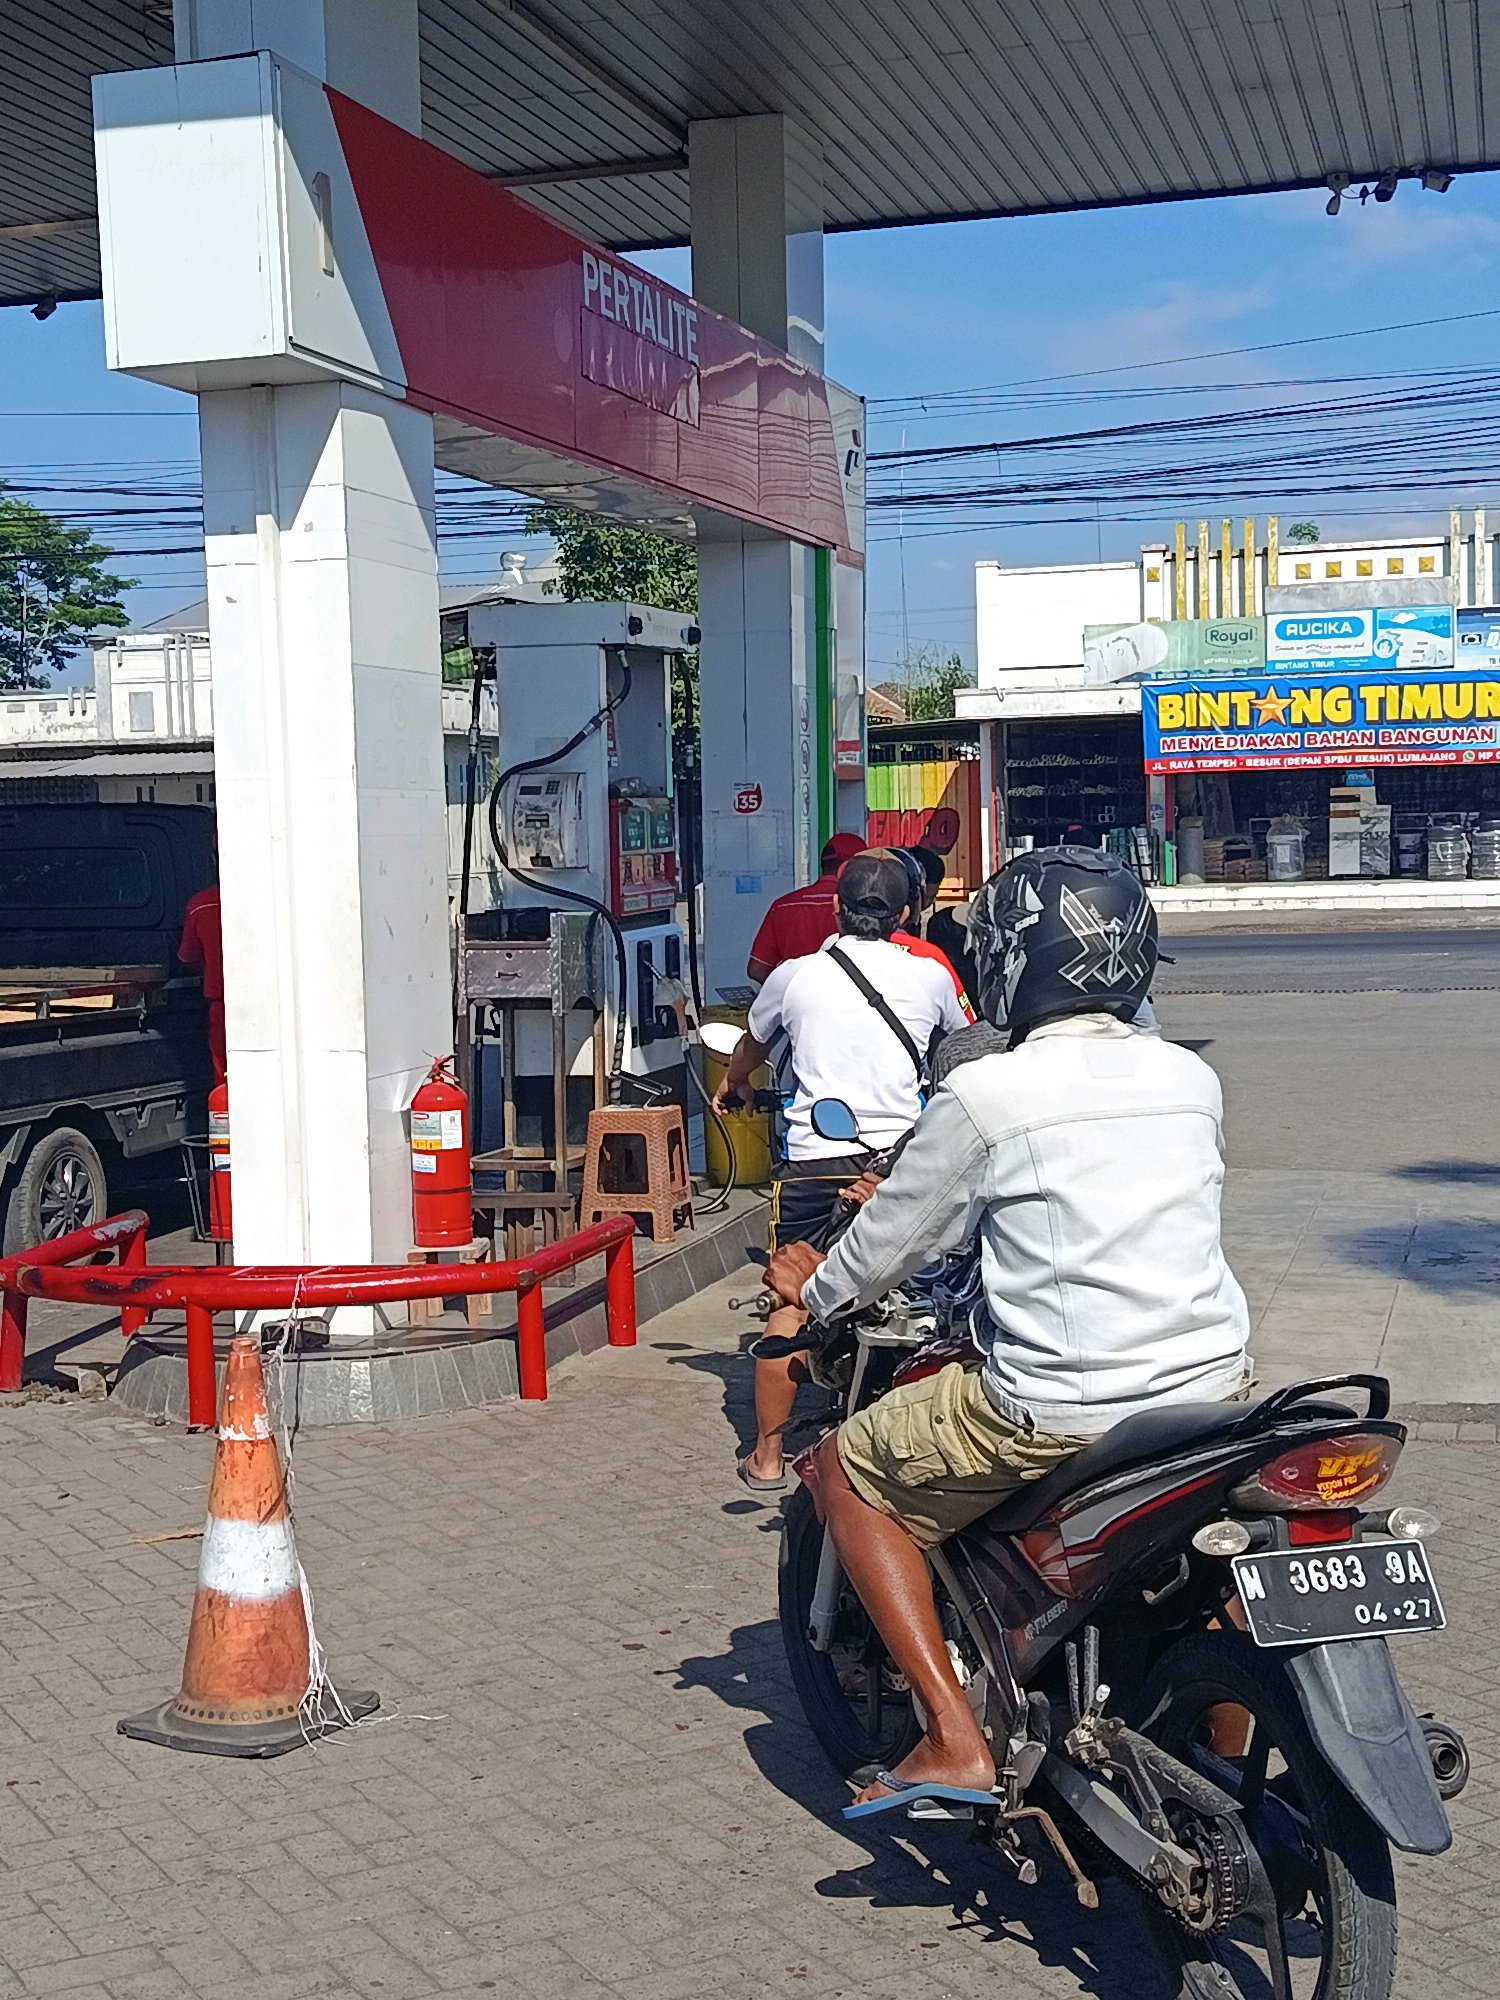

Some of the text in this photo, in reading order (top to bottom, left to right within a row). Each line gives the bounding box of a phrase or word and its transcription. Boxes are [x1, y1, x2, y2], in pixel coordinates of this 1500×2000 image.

[582, 250, 699, 365] PERTALITE
[1210, 629, 1253, 645] Royal
[1286, 621, 1353, 637] RUCIKA
[1275, 661, 1309, 670] BINTANG
[1311, 660, 1335, 669] TIMUR
[1158, 681, 1500, 730] BINTNG TIMUR
[1161, 727, 1494, 751] MENYEDIAKAN BAHAN BANGUNAN
[1152, 762, 1167, 771] JL.
[1170, 760, 1194, 770] RAYA
[1197, 759, 1237, 769] TEMPEH
[1245, 757, 1281, 767] BESUK
[1283, 756, 1321, 769] (DEPAN
[1324, 754, 1351, 764] SPBU
[1355, 753, 1395, 766] BESUK)
[1397, 752, 1457, 763] LUMAJANG
[1478, 751, 1494, 760] HP
[1239, 1564, 1266, 1600] N
[1289, 1554, 1366, 1594] 3683
